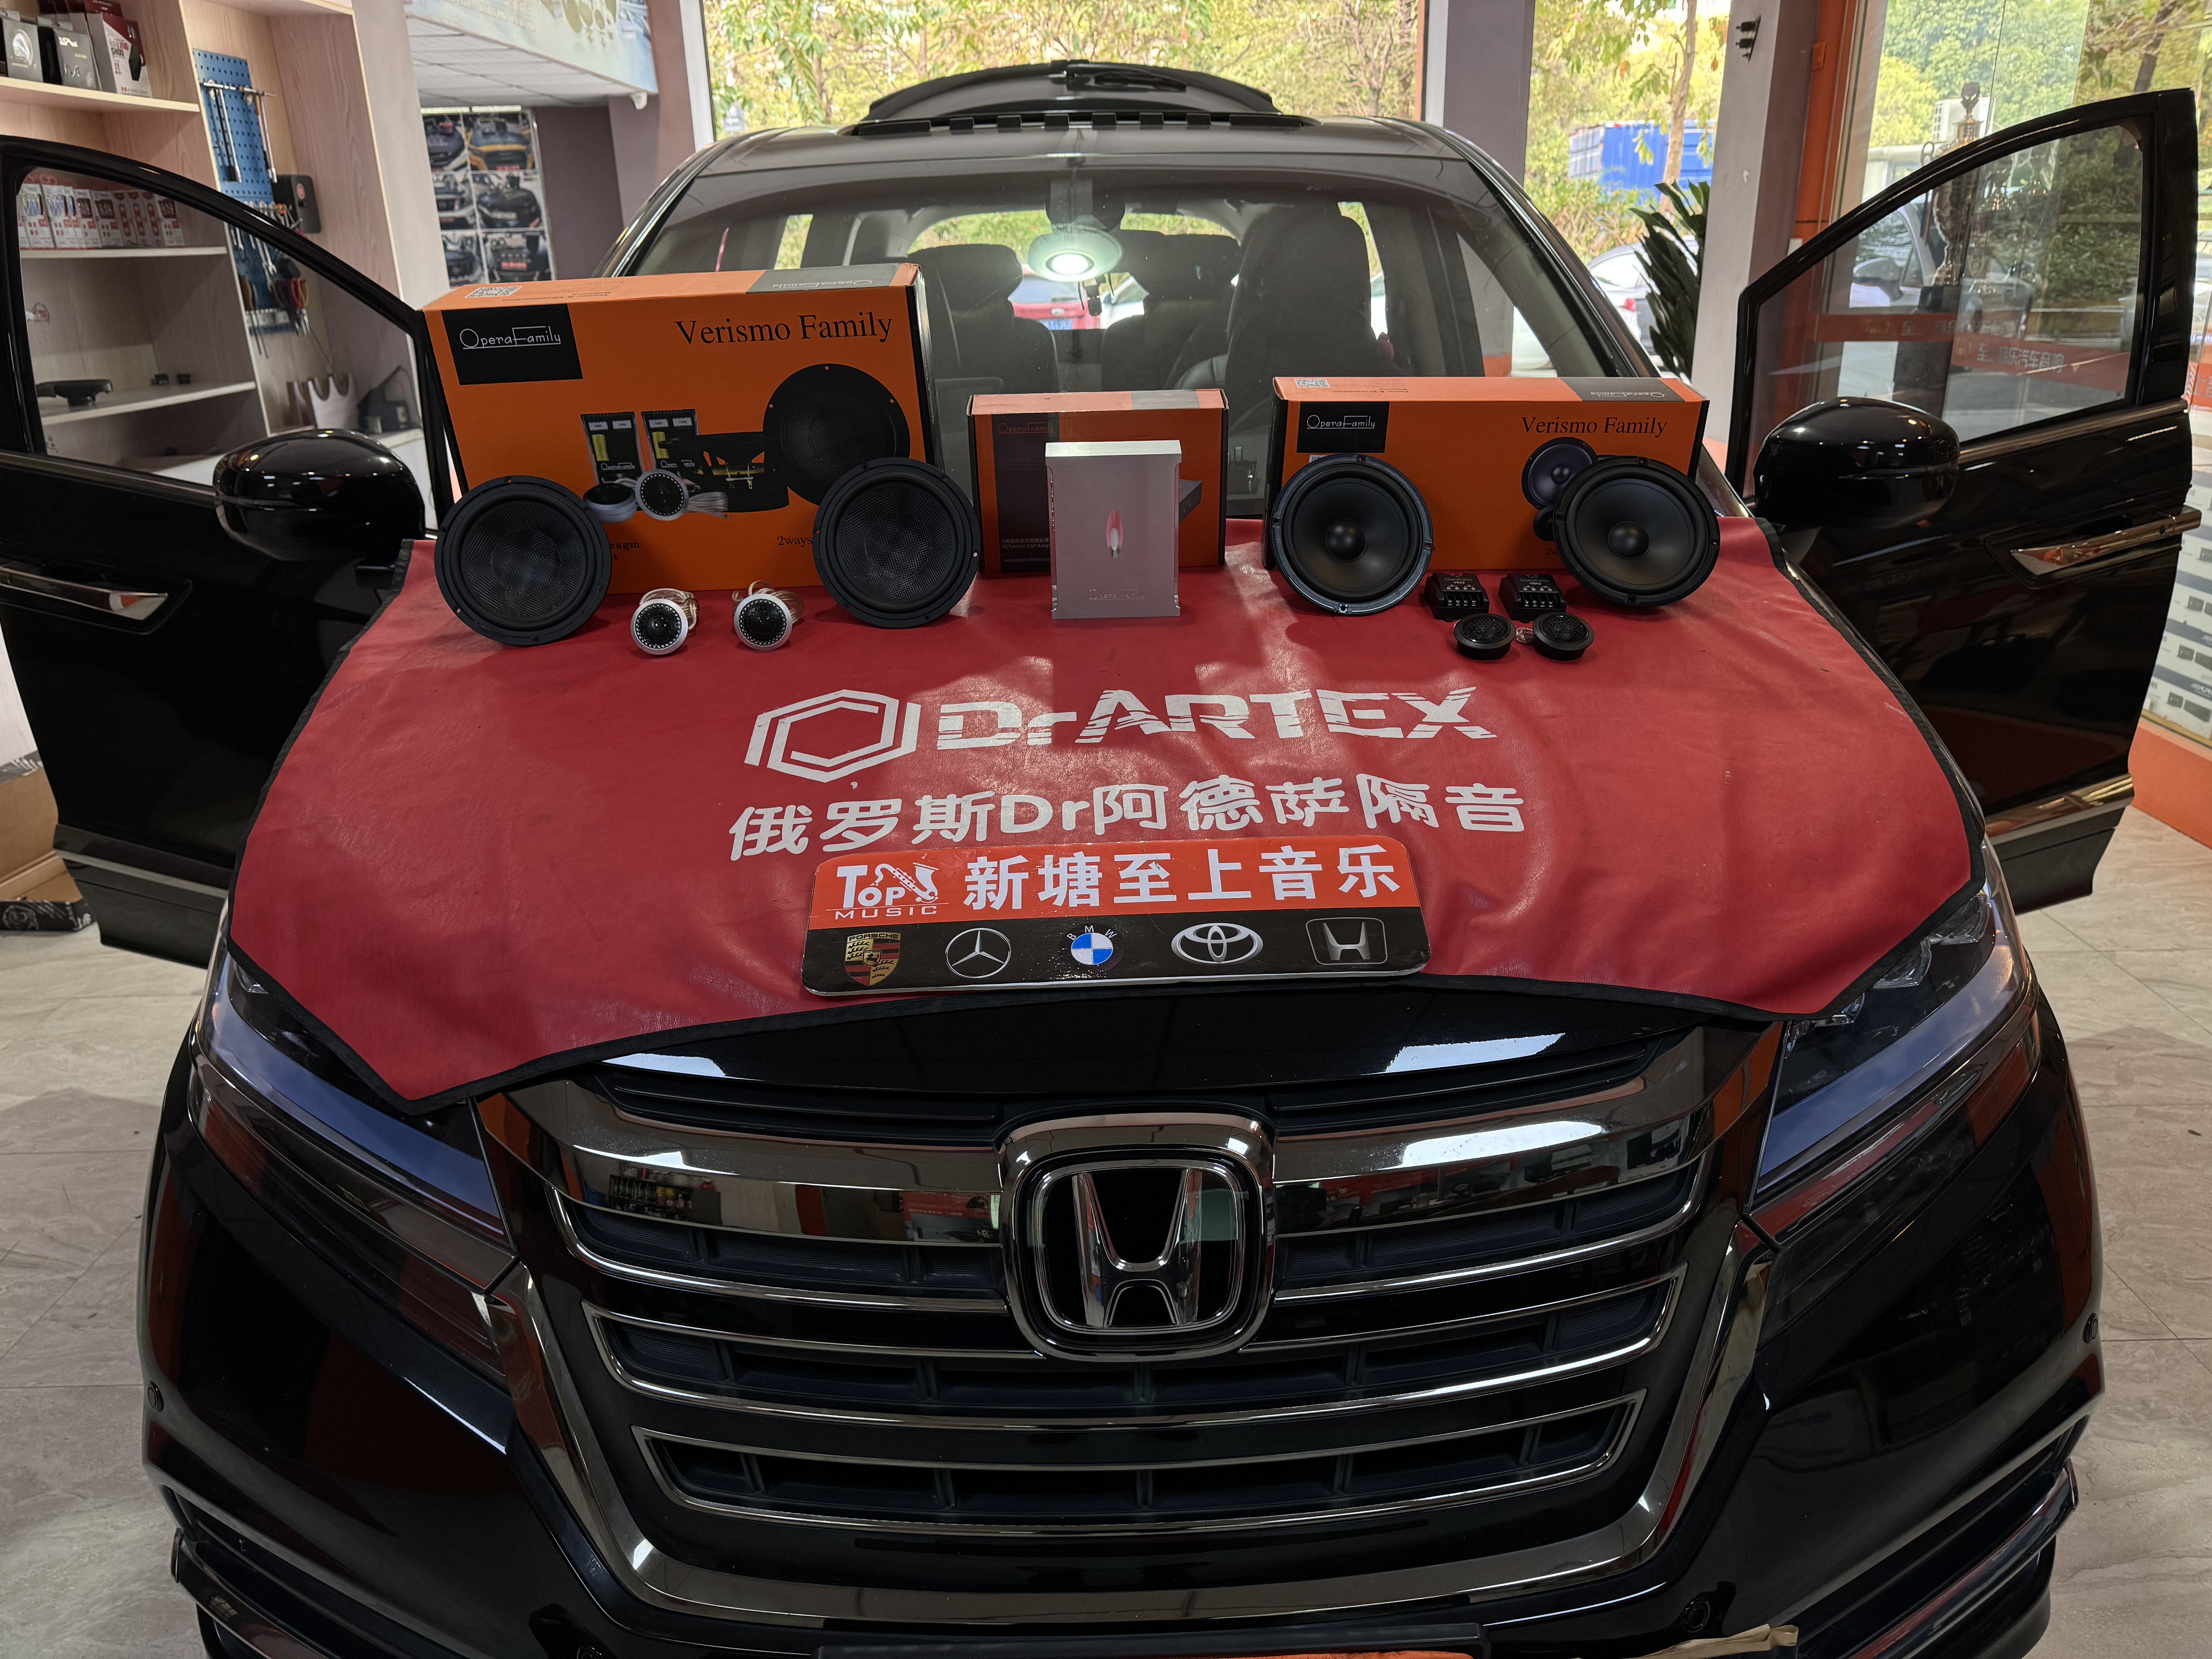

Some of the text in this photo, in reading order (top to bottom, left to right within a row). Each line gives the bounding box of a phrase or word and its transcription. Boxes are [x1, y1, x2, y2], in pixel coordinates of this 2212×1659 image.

[459, 326, 561, 349] OperaFamily
[675, 312, 892, 344] Verismo Family
[998, 422, 1053, 434] OperaFamily
[1307, 415, 1375, 429] OperaFamily
[1522, 417, 1667, 438] Verismo Family
[728, 774, 1525, 861] 俄罗斯Dr阿德萨隔音
[963, 844, 1400, 910] 新塘至上音乐
[835, 905, 937, 920] MUSIC
[1067, 925, 1118, 940] BMW
